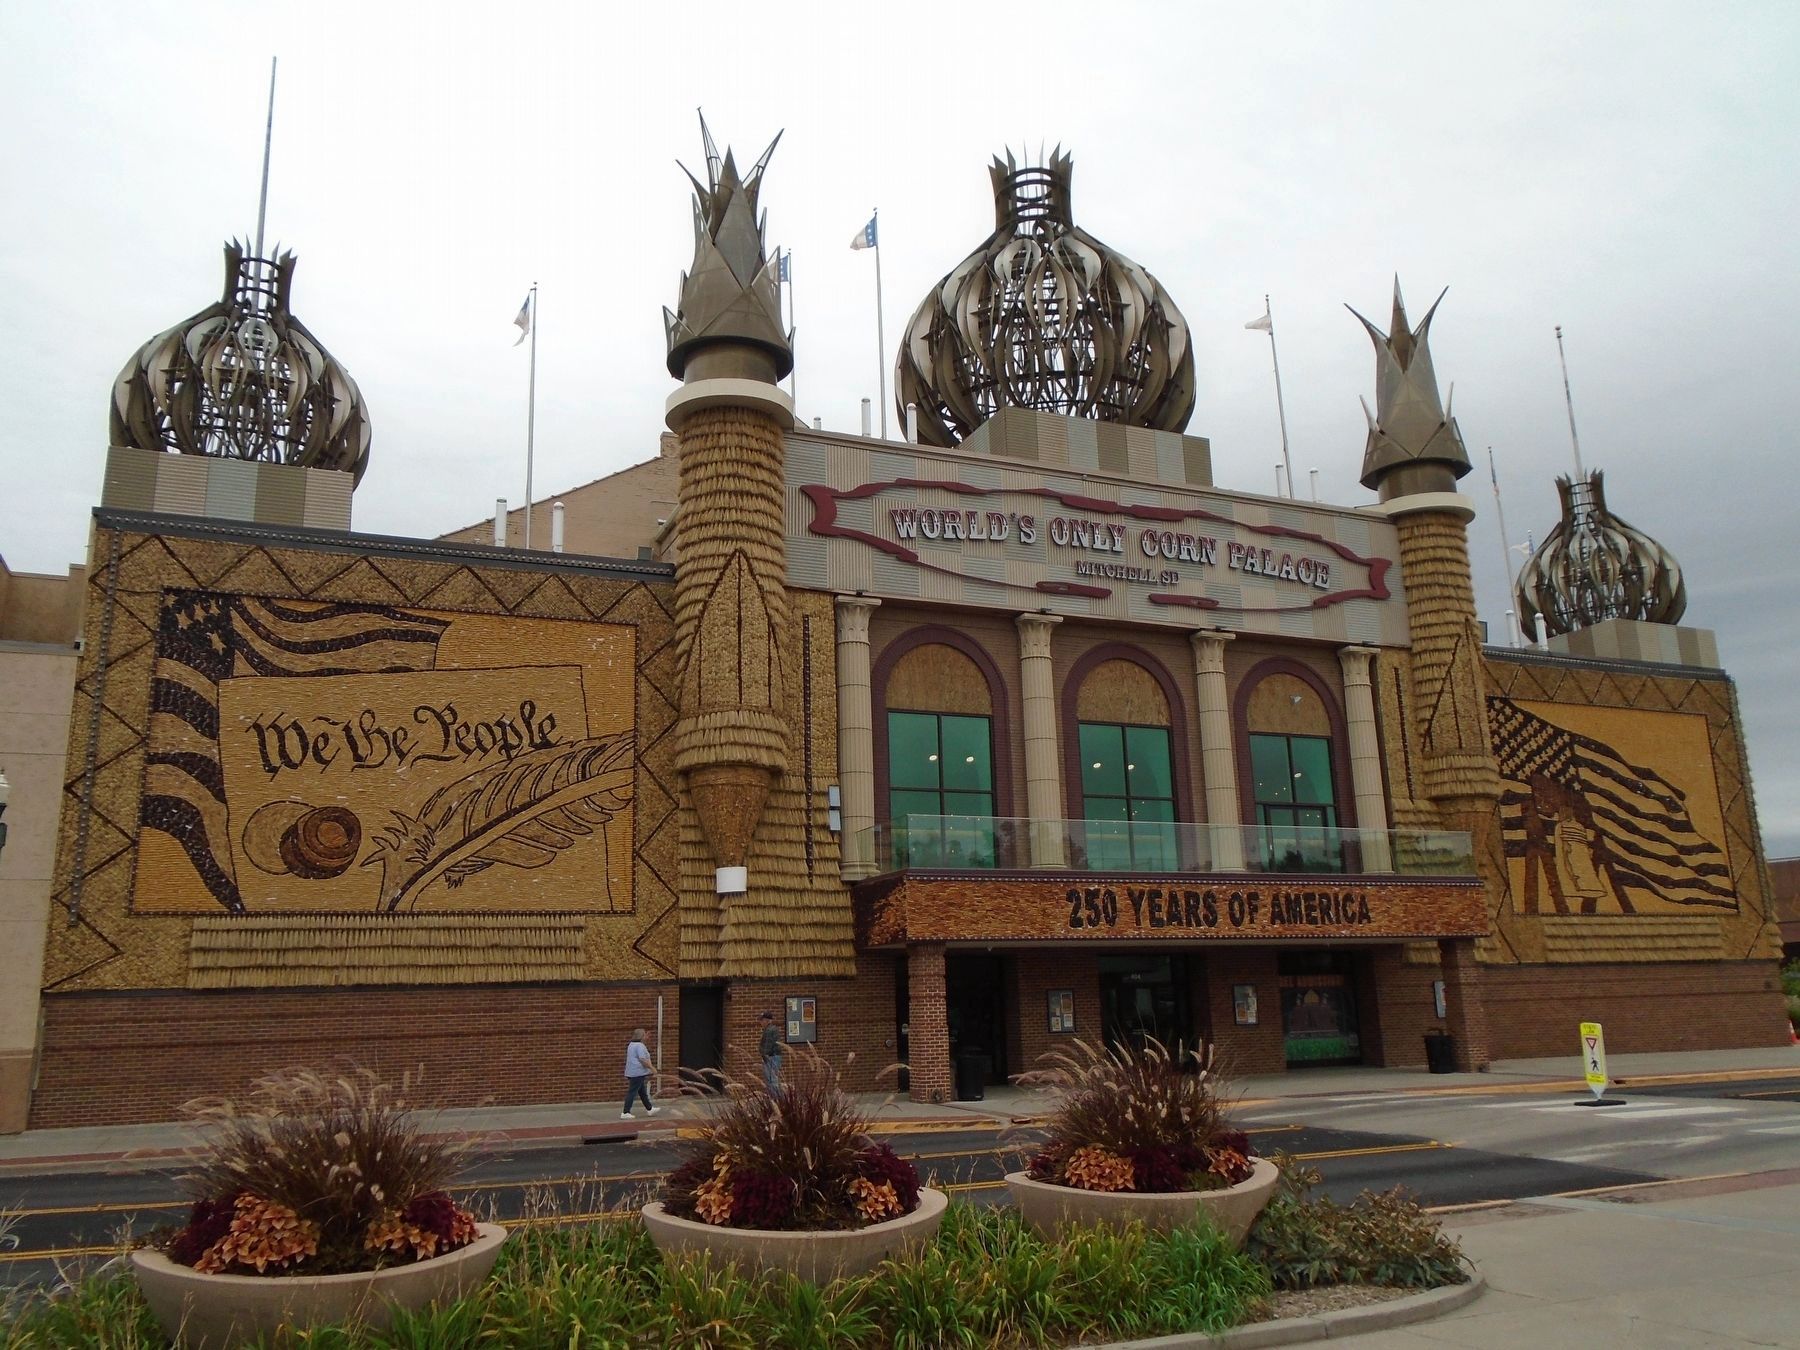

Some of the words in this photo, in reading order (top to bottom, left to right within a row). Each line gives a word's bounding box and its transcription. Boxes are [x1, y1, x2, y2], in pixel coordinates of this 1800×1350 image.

[890, 508, 1037, 544] WORLD'S
[1051, 516, 1127, 552] ONLY
[1141, 529, 1217, 565] CORN
[1228, 541, 1330, 589] PALACE
[1160, 571, 1179, 584] SD
[245, 712, 341, 782] We
[410, 700, 563, 769] People
[1066, 888, 1117, 928] 250
[1126, 888, 1218, 928] YEARS
[1228, 891, 1260, 927] OF
[1270, 891, 1372, 926] AMERICA
